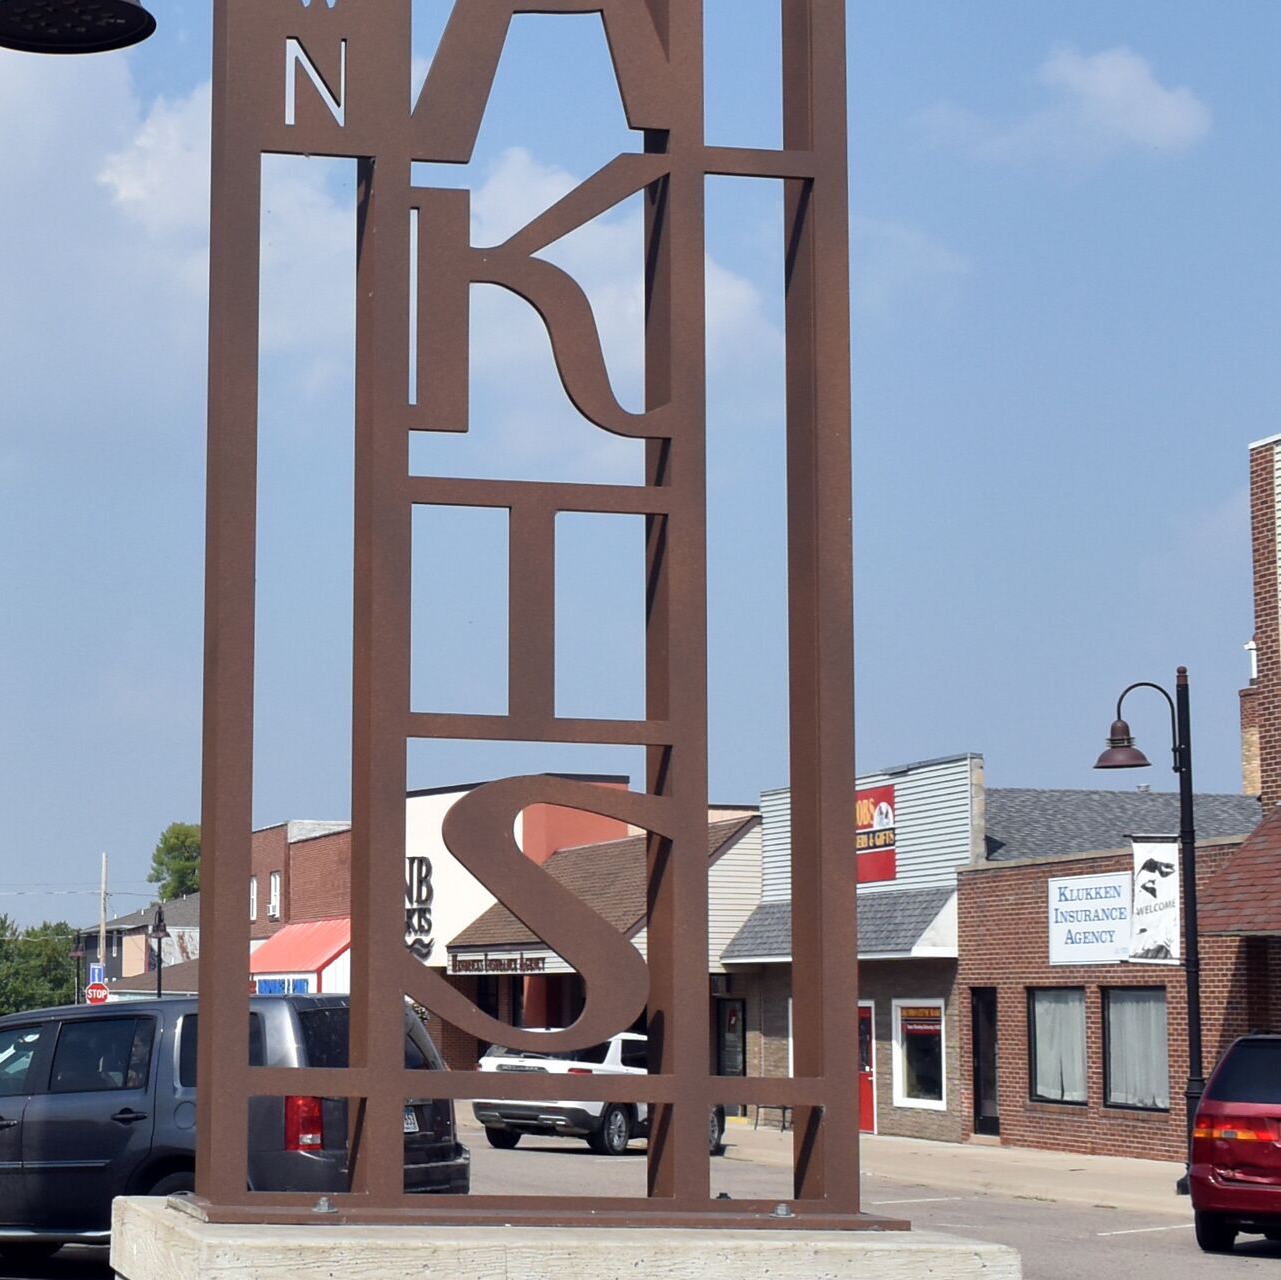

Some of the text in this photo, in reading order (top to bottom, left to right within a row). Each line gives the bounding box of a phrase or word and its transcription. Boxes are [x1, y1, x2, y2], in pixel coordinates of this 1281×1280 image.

[1057, 885, 1122, 902] KLUKKEN
[1054, 906, 1127, 924] INSURANCE
[1136, 898, 1177, 917] WELCOME
[1064, 929, 1116, 945] AGENCY
[87, 989, 107, 999] STOP
